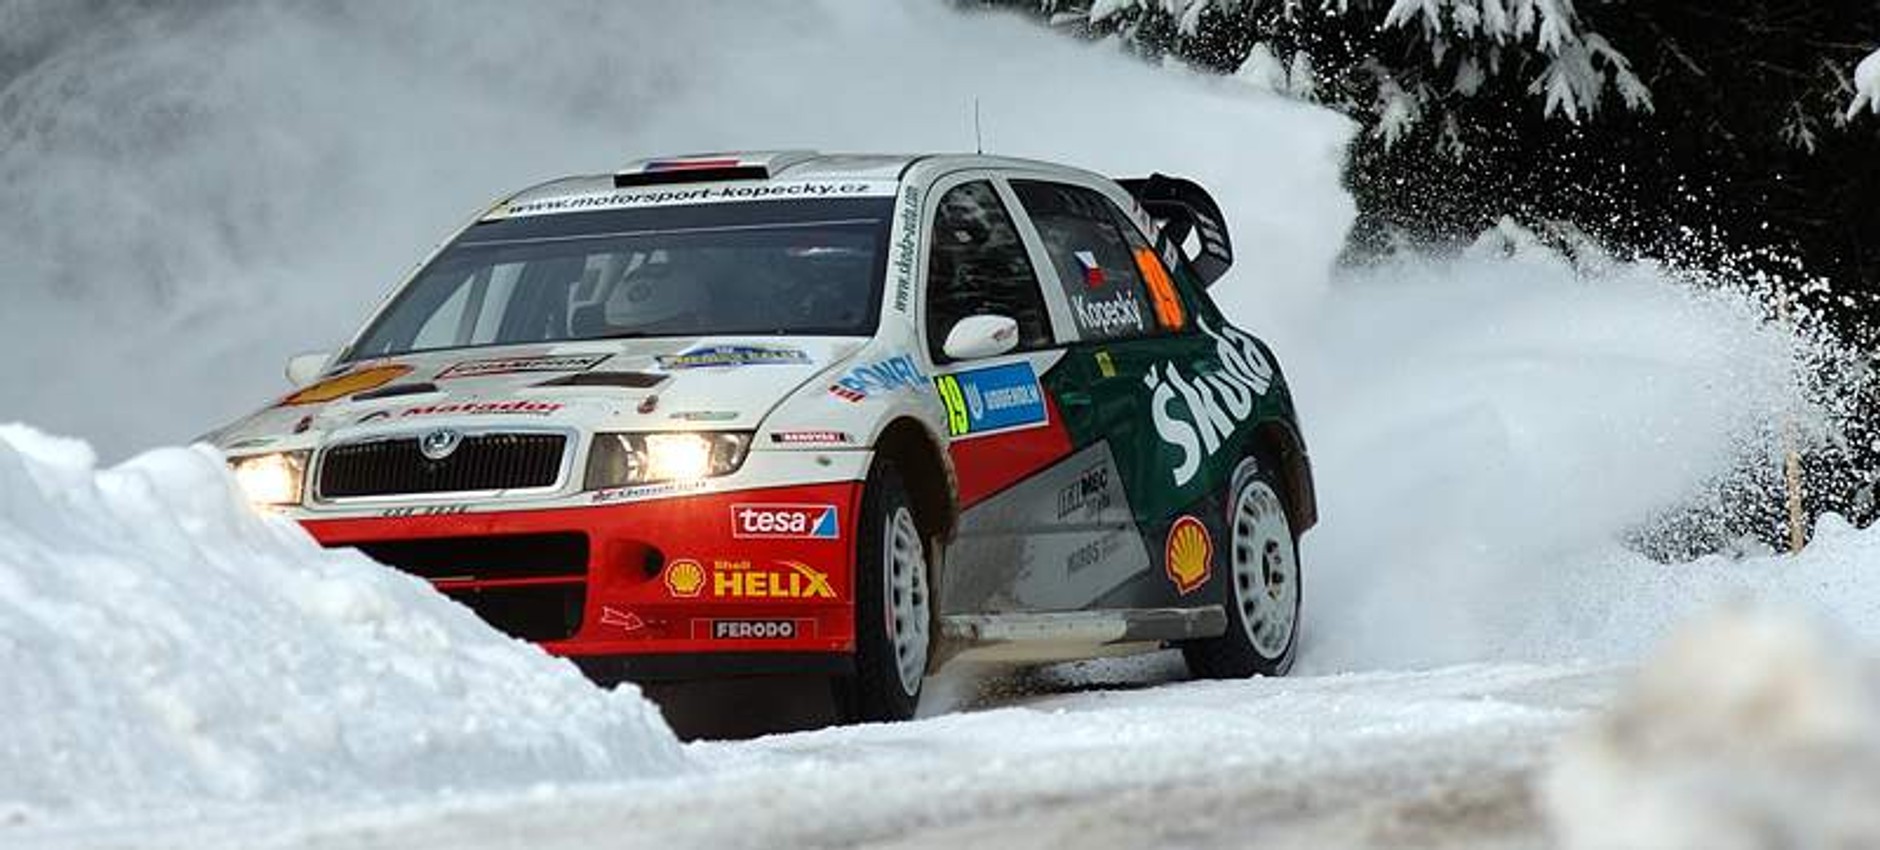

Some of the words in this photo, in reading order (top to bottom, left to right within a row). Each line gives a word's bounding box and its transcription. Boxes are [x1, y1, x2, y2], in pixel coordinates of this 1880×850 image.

[508, 182, 870, 214] www.motorsport-kopecky.cz
[1071, 288, 1144, 334] Kopecký
[937, 375, 969, 436] 19
[739, 508, 806, 532] tesa
[714, 565, 836, 597] HELIX
[716, 621, 793, 638] FERODO
